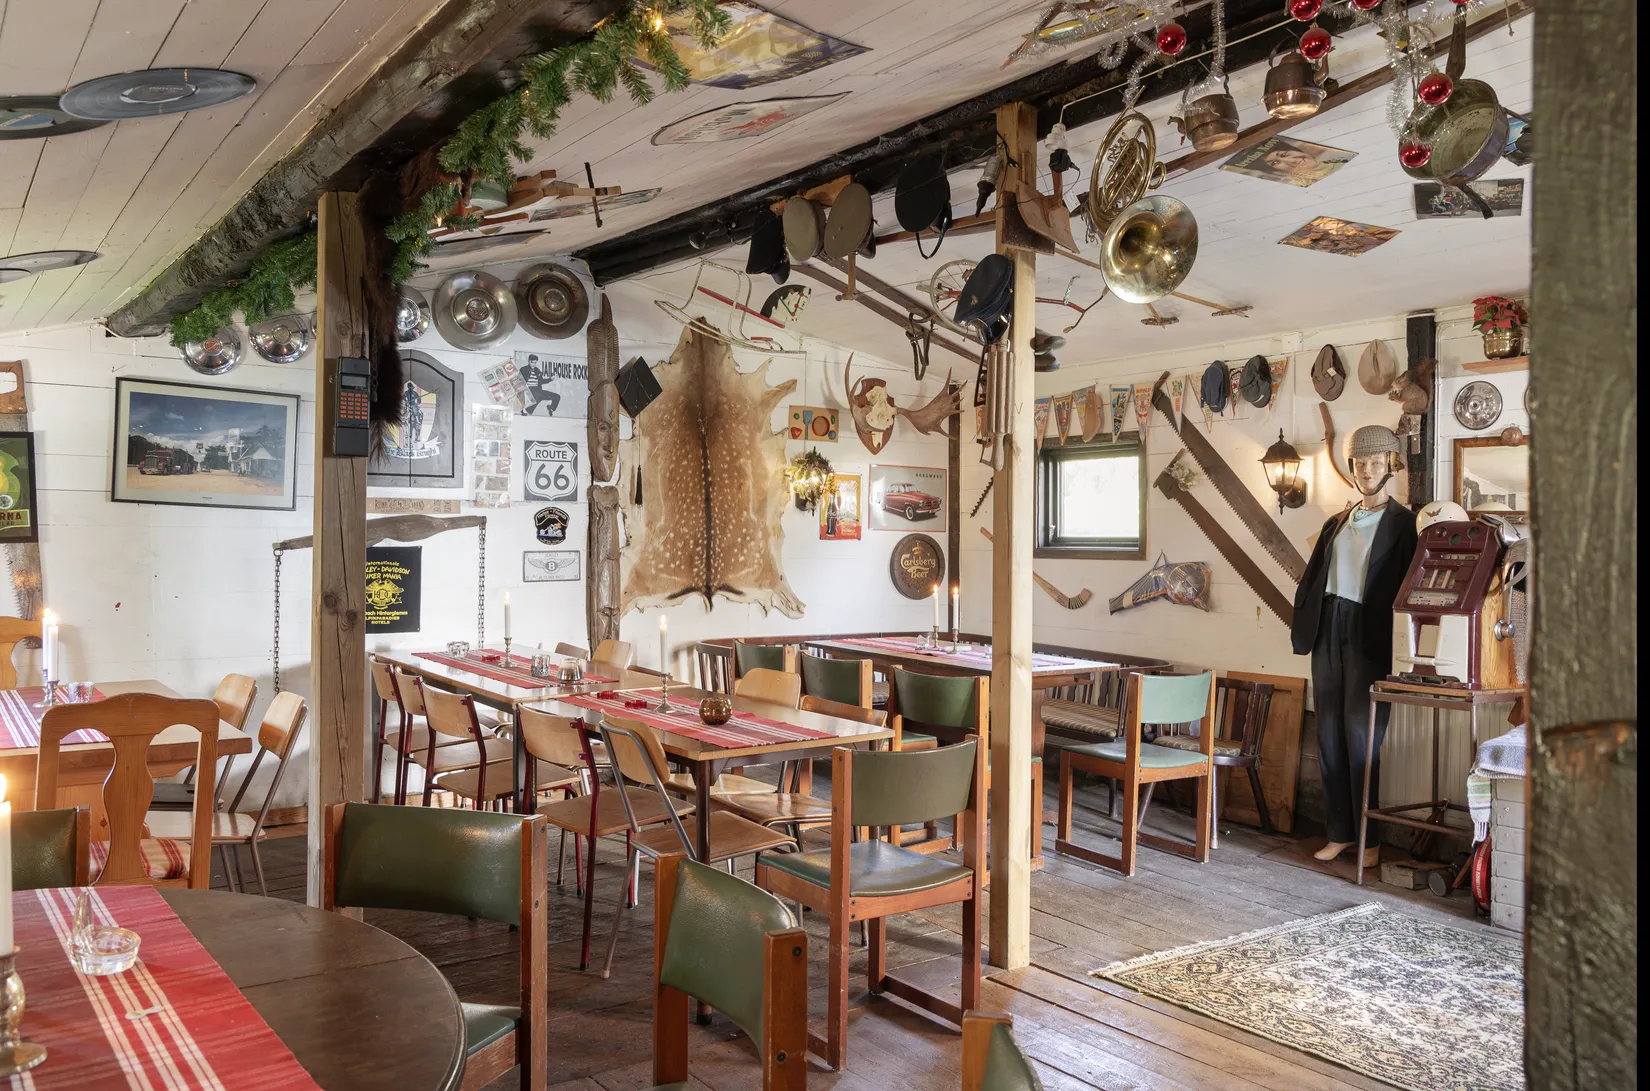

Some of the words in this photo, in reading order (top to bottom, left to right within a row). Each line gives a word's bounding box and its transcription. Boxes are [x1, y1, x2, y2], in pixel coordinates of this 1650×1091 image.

[541, 360, 571, 379] JAILHOUSE
[572, 363, 588, 380] ROCK
[535, 449, 568, 460] ROUTE
[534, 462, 570, 490] 66
[900, 553, 936, 570] Carlsberg
[910, 568, 929, 579] Beer
